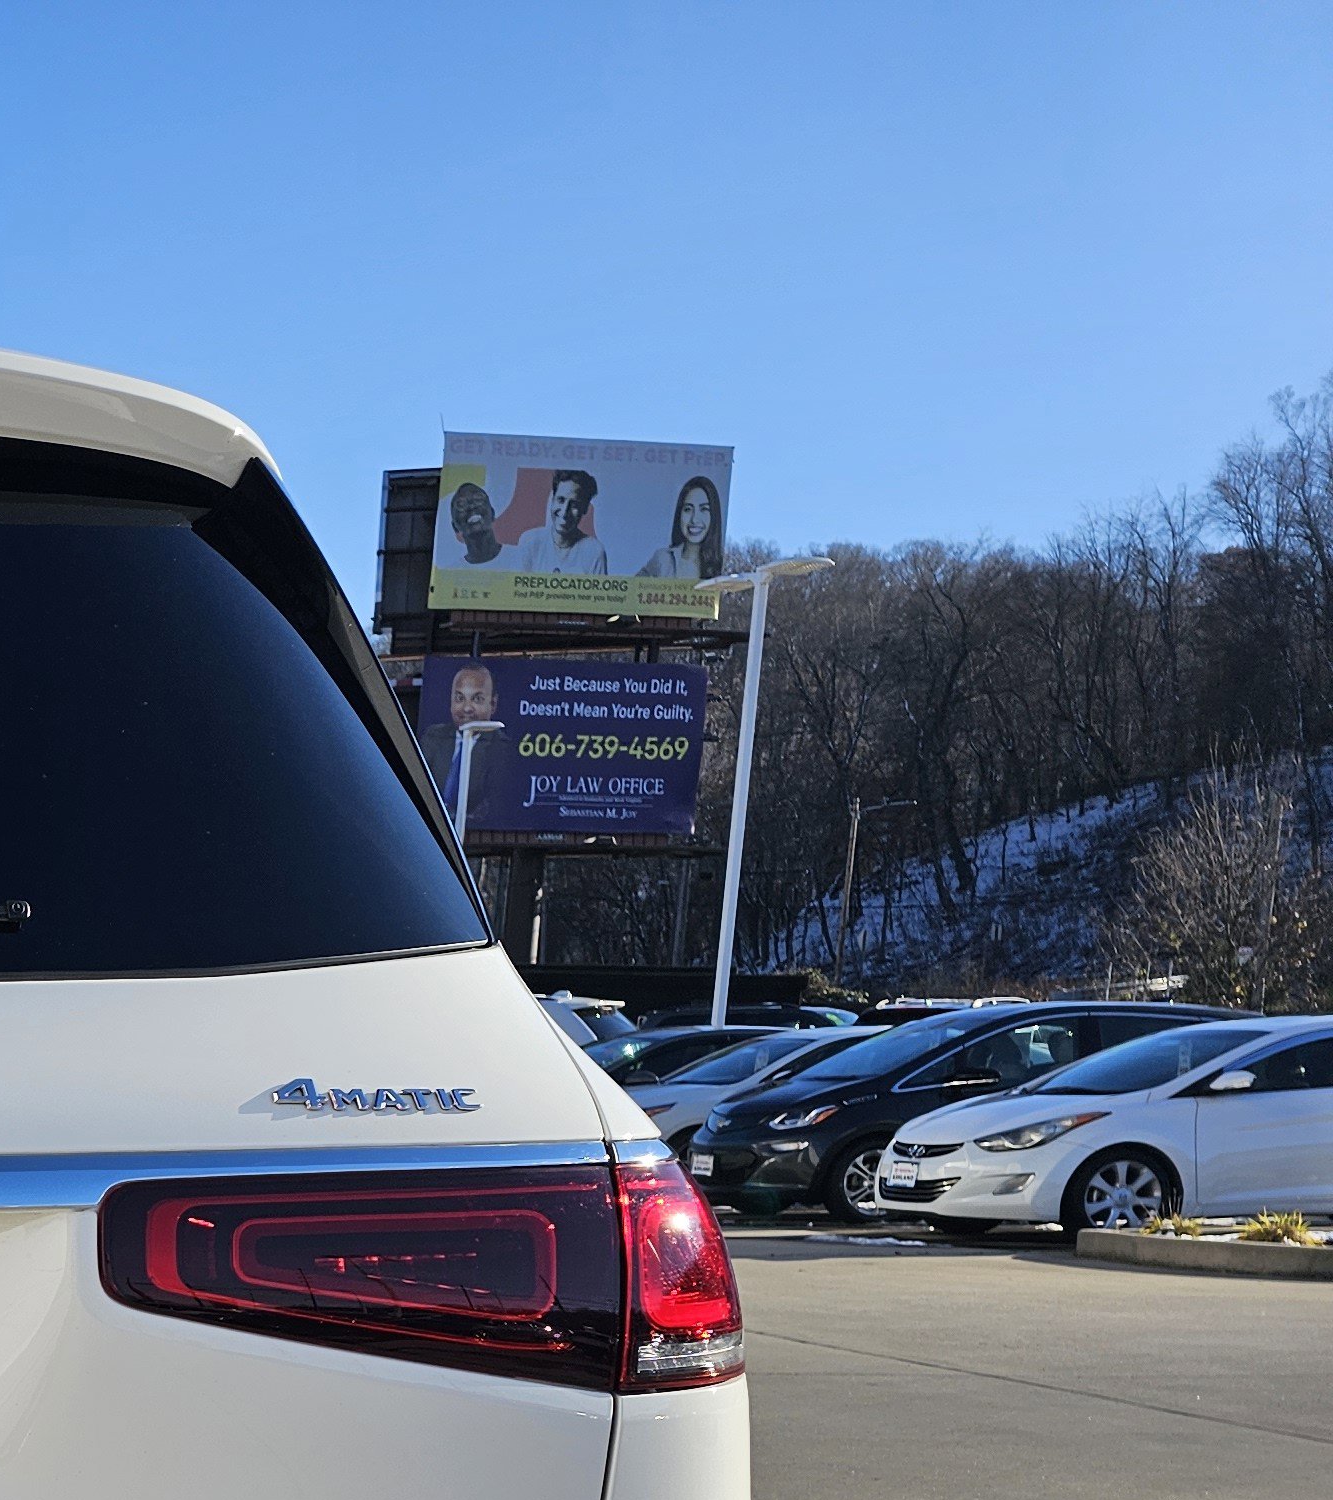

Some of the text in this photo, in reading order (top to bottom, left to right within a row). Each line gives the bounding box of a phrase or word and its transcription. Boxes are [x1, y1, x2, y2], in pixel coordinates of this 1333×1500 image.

[450, 438, 484, 455] GET
[492, 440, 555, 458] READY.
[562, 445, 598, 460] GET
[644, 449, 679, 464] GET
[514, 576, 628, 592] PREPLOCATOR.ORG
[530, 675, 688, 697] Just Because You Did It,
[519, 700, 694, 723] Doesn't Mean You're Guilty.
[518, 733, 690, 761] 606-739-4569
[523, 775, 562, 807] JOY
[566, 775, 603, 794] LAW
[608, 776, 664, 795] OFFICE
[272, 1078, 484, 1111] 4MATIC
